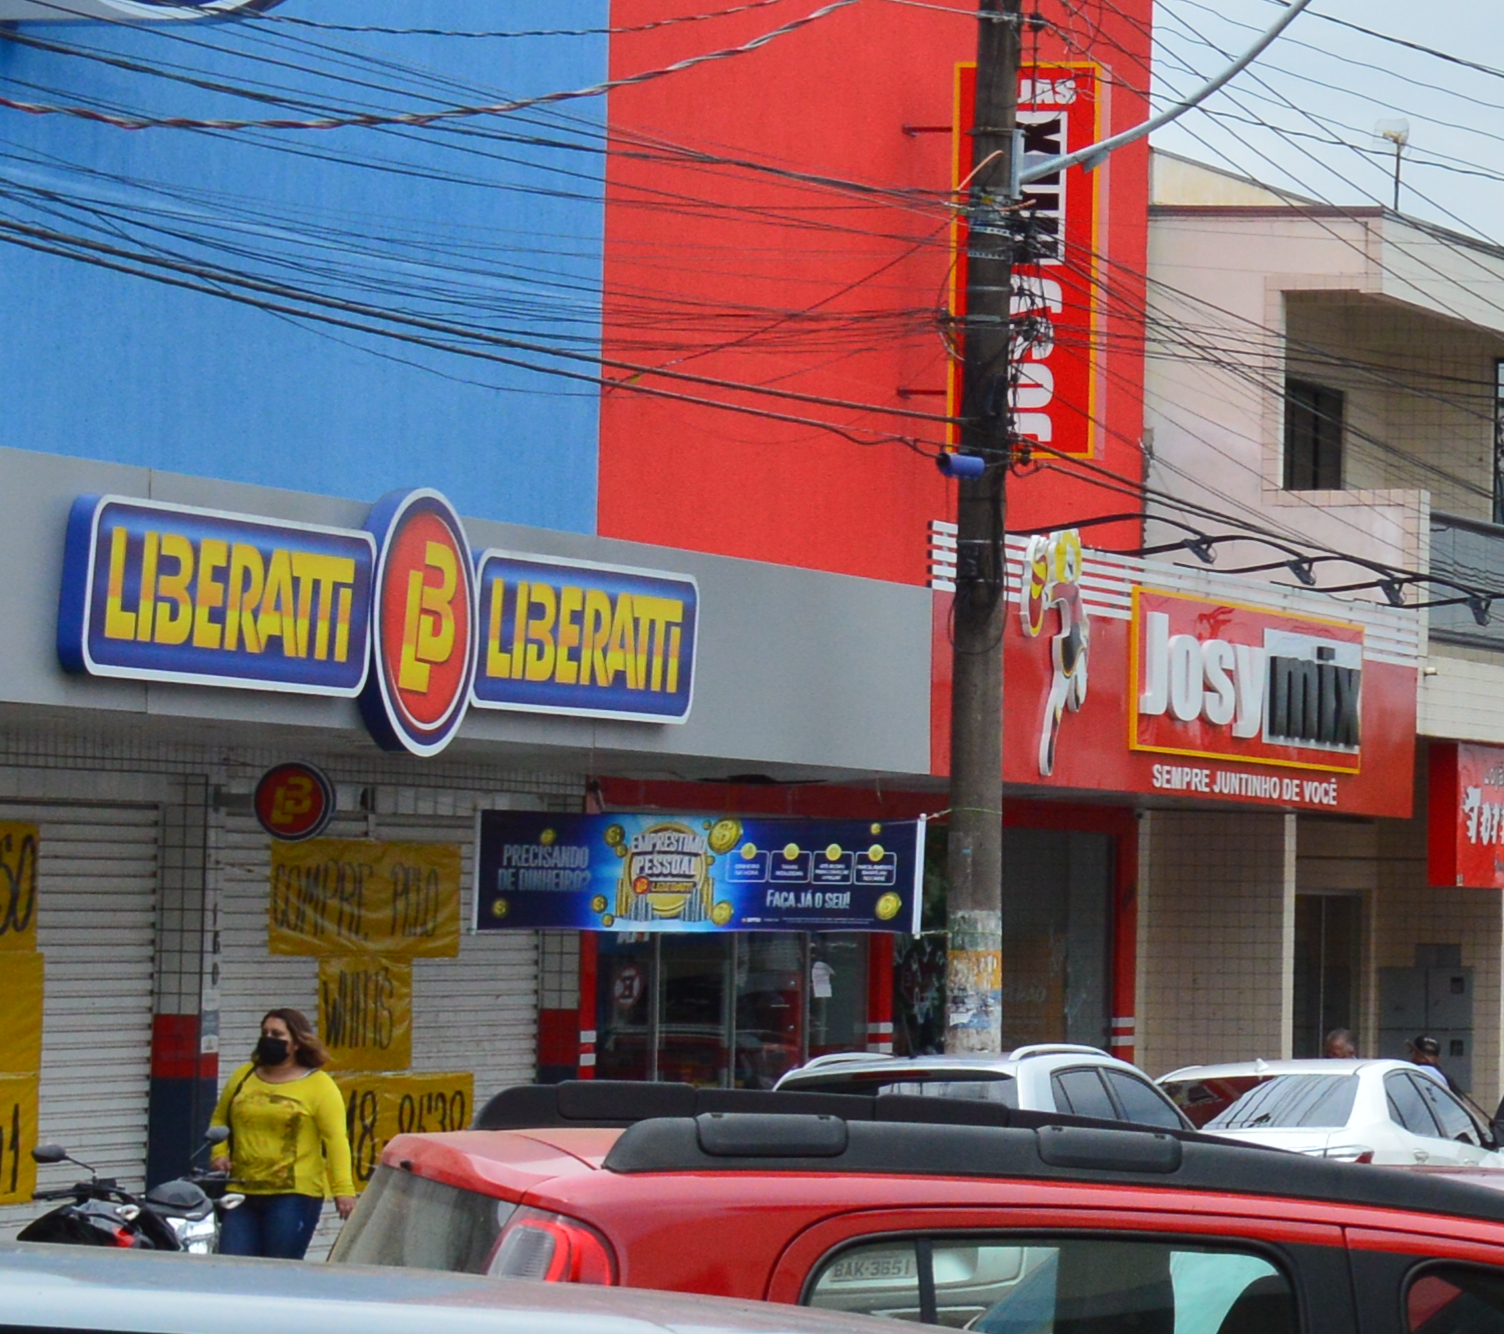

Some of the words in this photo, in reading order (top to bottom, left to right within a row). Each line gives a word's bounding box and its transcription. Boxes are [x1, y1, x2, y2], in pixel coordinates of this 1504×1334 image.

[1017, 78, 1077, 105] JAS
[103, 526, 355, 663] LIBERATTI
[485, 578, 683, 693] LIBERATTI
[1152, 763, 1211, 793] SEMPRE
[1213, 770, 1279, 800] JUNTINHO
[1282, 778, 1301, 801] DE
[1303, 778, 1338, 805] VOCÊ
[631, 830, 707, 853] EMPRÉSTIMO
[503, 844, 589, 868] PRECISANDO
[636, 854, 698, 877] PESSOAL
[498, 868, 517, 891] DE
[518, 869, 592, 892] DINHEIRO?
[273, 858, 374, 942] COMPRE
[766, 889, 795, 909] FAÇA
[797, 889, 812, 909] JÁ
[814, 891, 823, 909] O
[824, 891, 851, 909] SEU!
